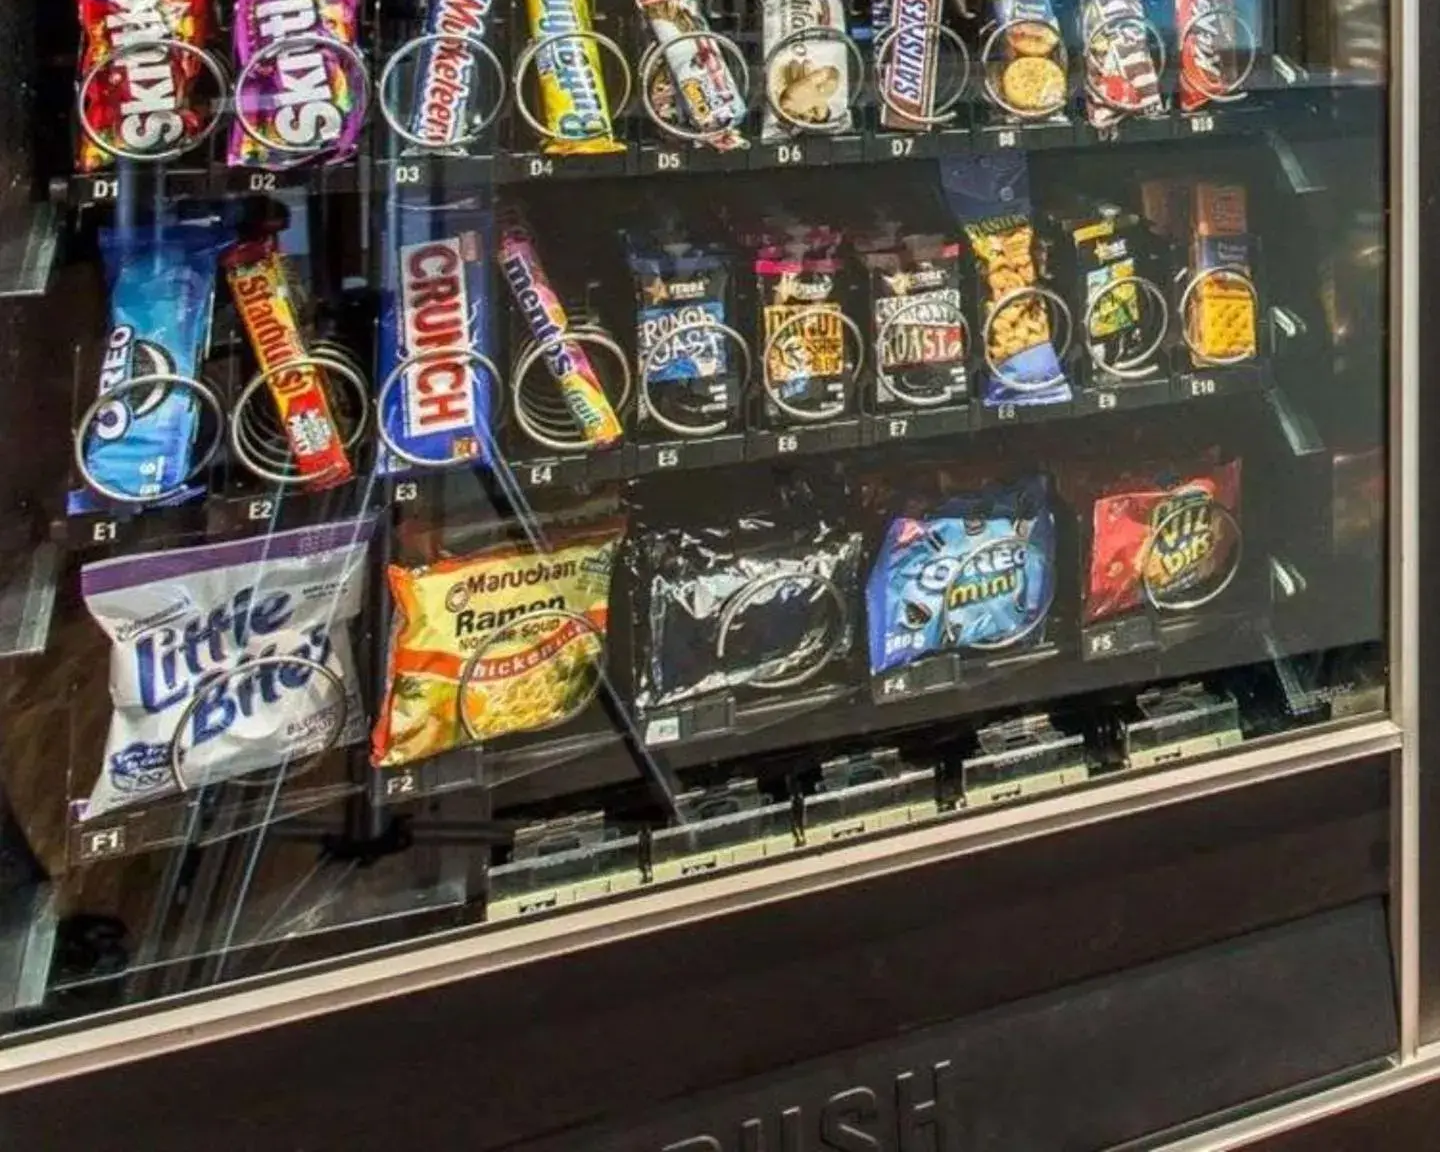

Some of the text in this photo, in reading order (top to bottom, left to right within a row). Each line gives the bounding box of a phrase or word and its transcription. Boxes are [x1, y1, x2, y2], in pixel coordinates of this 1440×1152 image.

[892, 140, 914, 155] D7
[658, 154, 680, 167] D5
[778, 149, 801, 163] D6
[396, 167, 419, 182] D3
[531, 161, 553, 176] D4
[94, 180, 118, 197] D1
[250, 175, 276, 191] D2
[505, 256, 573, 378] mentos
[408, 244, 467, 426] CRUNCH
[97, 325, 133, 440] OREO
[1192, 381, 1215, 395] E10
[890, 421, 908, 436] E7
[778, 437, 797, 452] E6
[658, 451, 678, 466] E5
[532, 468, 552, 483] E4
[396, 485, 418, 500] E3
[249, 502, 273, 519] E2
[93, 523, 117, 540] E1
[466, 559, 577, 594] Maruchan
[950, 573, 1016, 608] mini
[456, 594, 566, 637] Ramen
[136, 586, 294, 715] Little
[1092, 636, 1112, 651] F5
[884, 679, 905, 694] F4
[387, 775, 413, 793] F2
[91, 832, 118, 849] F1
